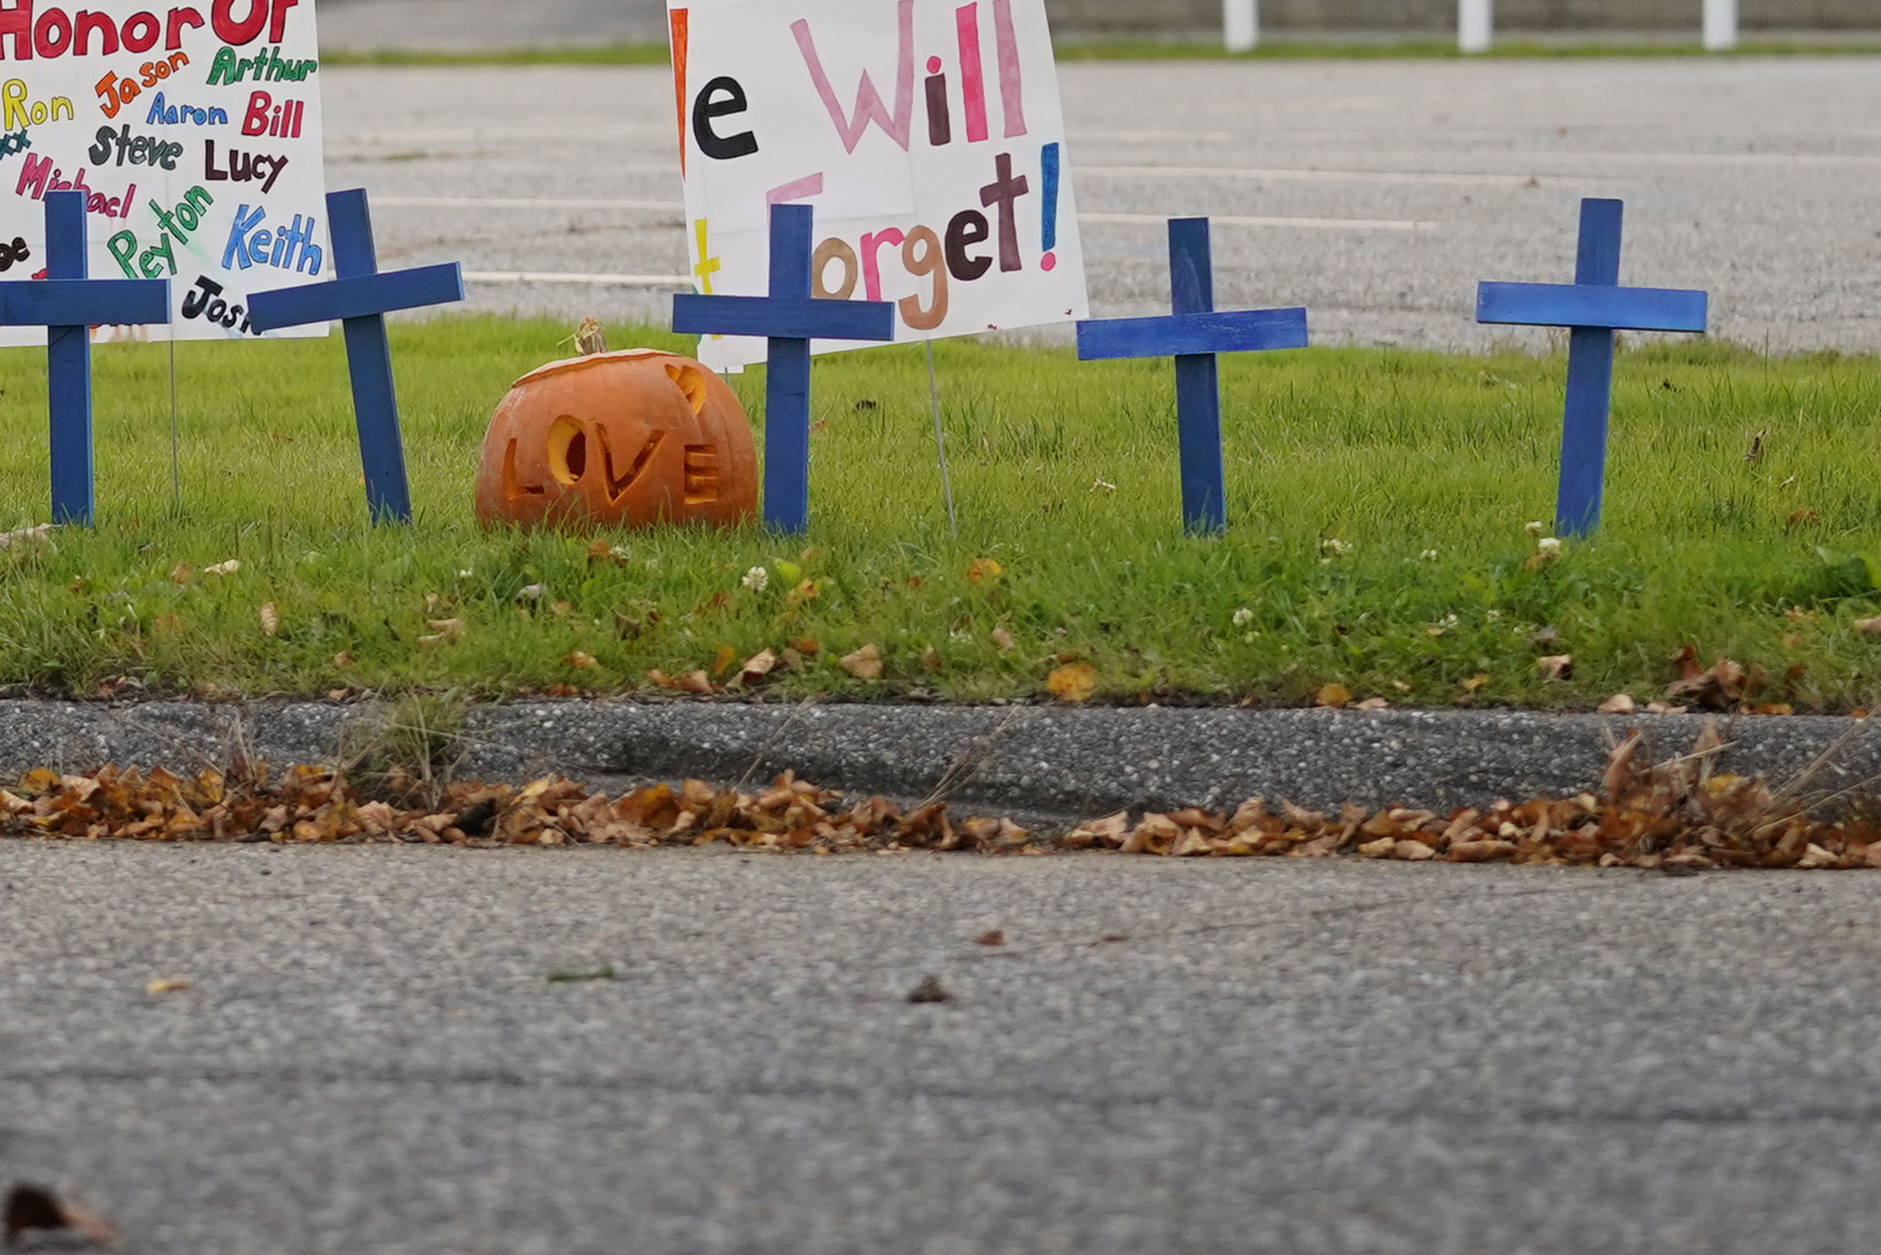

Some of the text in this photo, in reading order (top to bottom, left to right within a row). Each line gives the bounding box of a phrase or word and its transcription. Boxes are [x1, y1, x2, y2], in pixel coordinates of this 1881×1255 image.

[94, 50, 190, 119] Jason
[206, 45, 318, 86] Arthur
[1, 78, 74, 131] Ron
[145, 91, 228, 126] Aaron
[240, 90, 304, 138] Bill
[88, 123, 184, 171] Steve
[204, 139, 289, 194] Lucy
[106, 184, 214, 280] Peyton
[221, 203, 323, 276] Keith
[502, 414, 718, 506] LOVE
